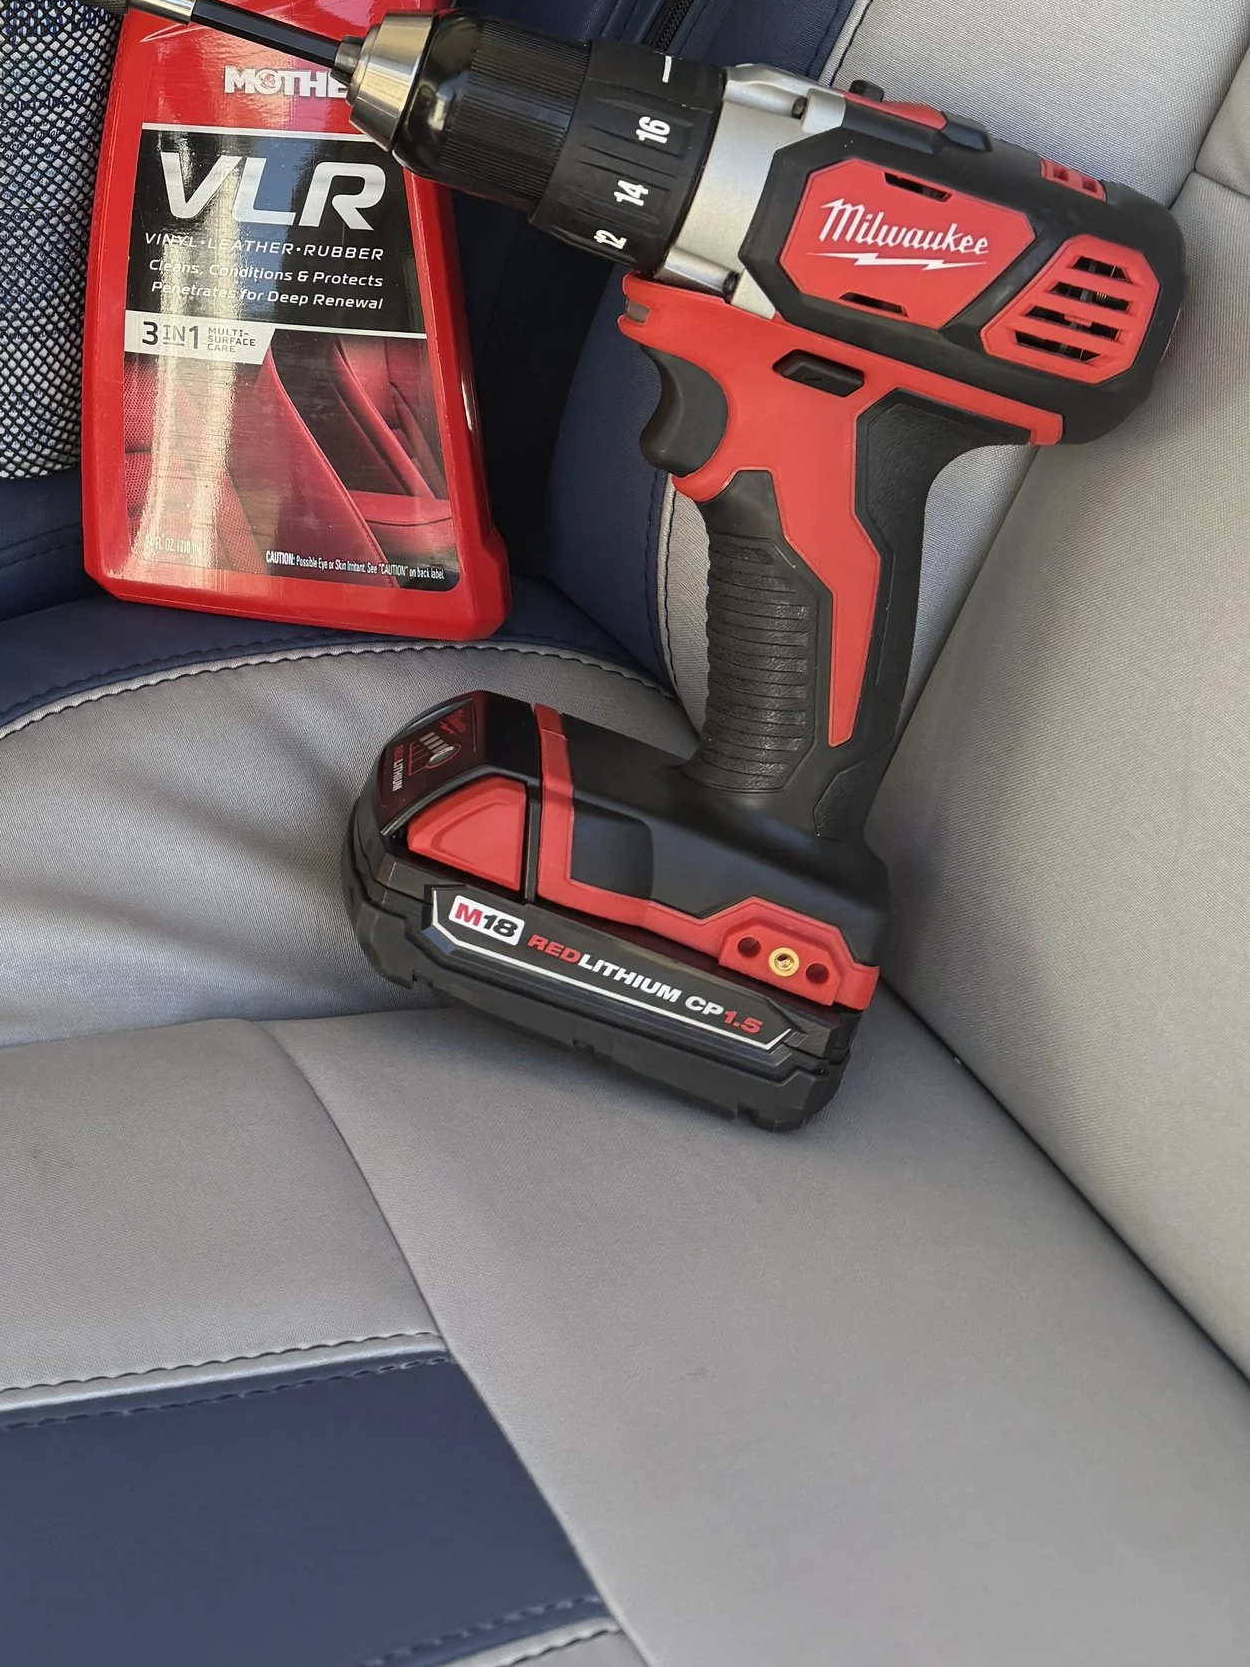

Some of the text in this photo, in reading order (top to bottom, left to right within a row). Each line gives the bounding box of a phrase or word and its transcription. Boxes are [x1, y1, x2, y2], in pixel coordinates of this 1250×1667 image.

[636, 116, 671, 143] 16
[160, 151, 386, 231] VLR
[614, 180, 649, 206] 14
[819, 198, 990, 255] Milwaukee
[149, 259, 384, 287] Cleans, Conditions & Protects
[151, 281, 384, 310] Penetrates for Deep Renewal
[141, 320, 199, 350] 3 IN 1
[207, 335, 256, 347] SURFACE
[208, 327, 249, 338] MULTI-
[207, 343, 236, 353] CARE
[265, 550, 296, 566] CAUTION:
[296, 554, 318, 568] Possible
[318, 557, 328, 571] Eye
[328, 561, 335, 570] or
[335, 559, 347, 571] Skin
[366, 562, 378, 574] See
[409, 568, 417, 578] on
[416, 566, 430, 578] back
[454, 902, 519, 938] M18
[527, 934, 683, 1003] REDLITHIUM
